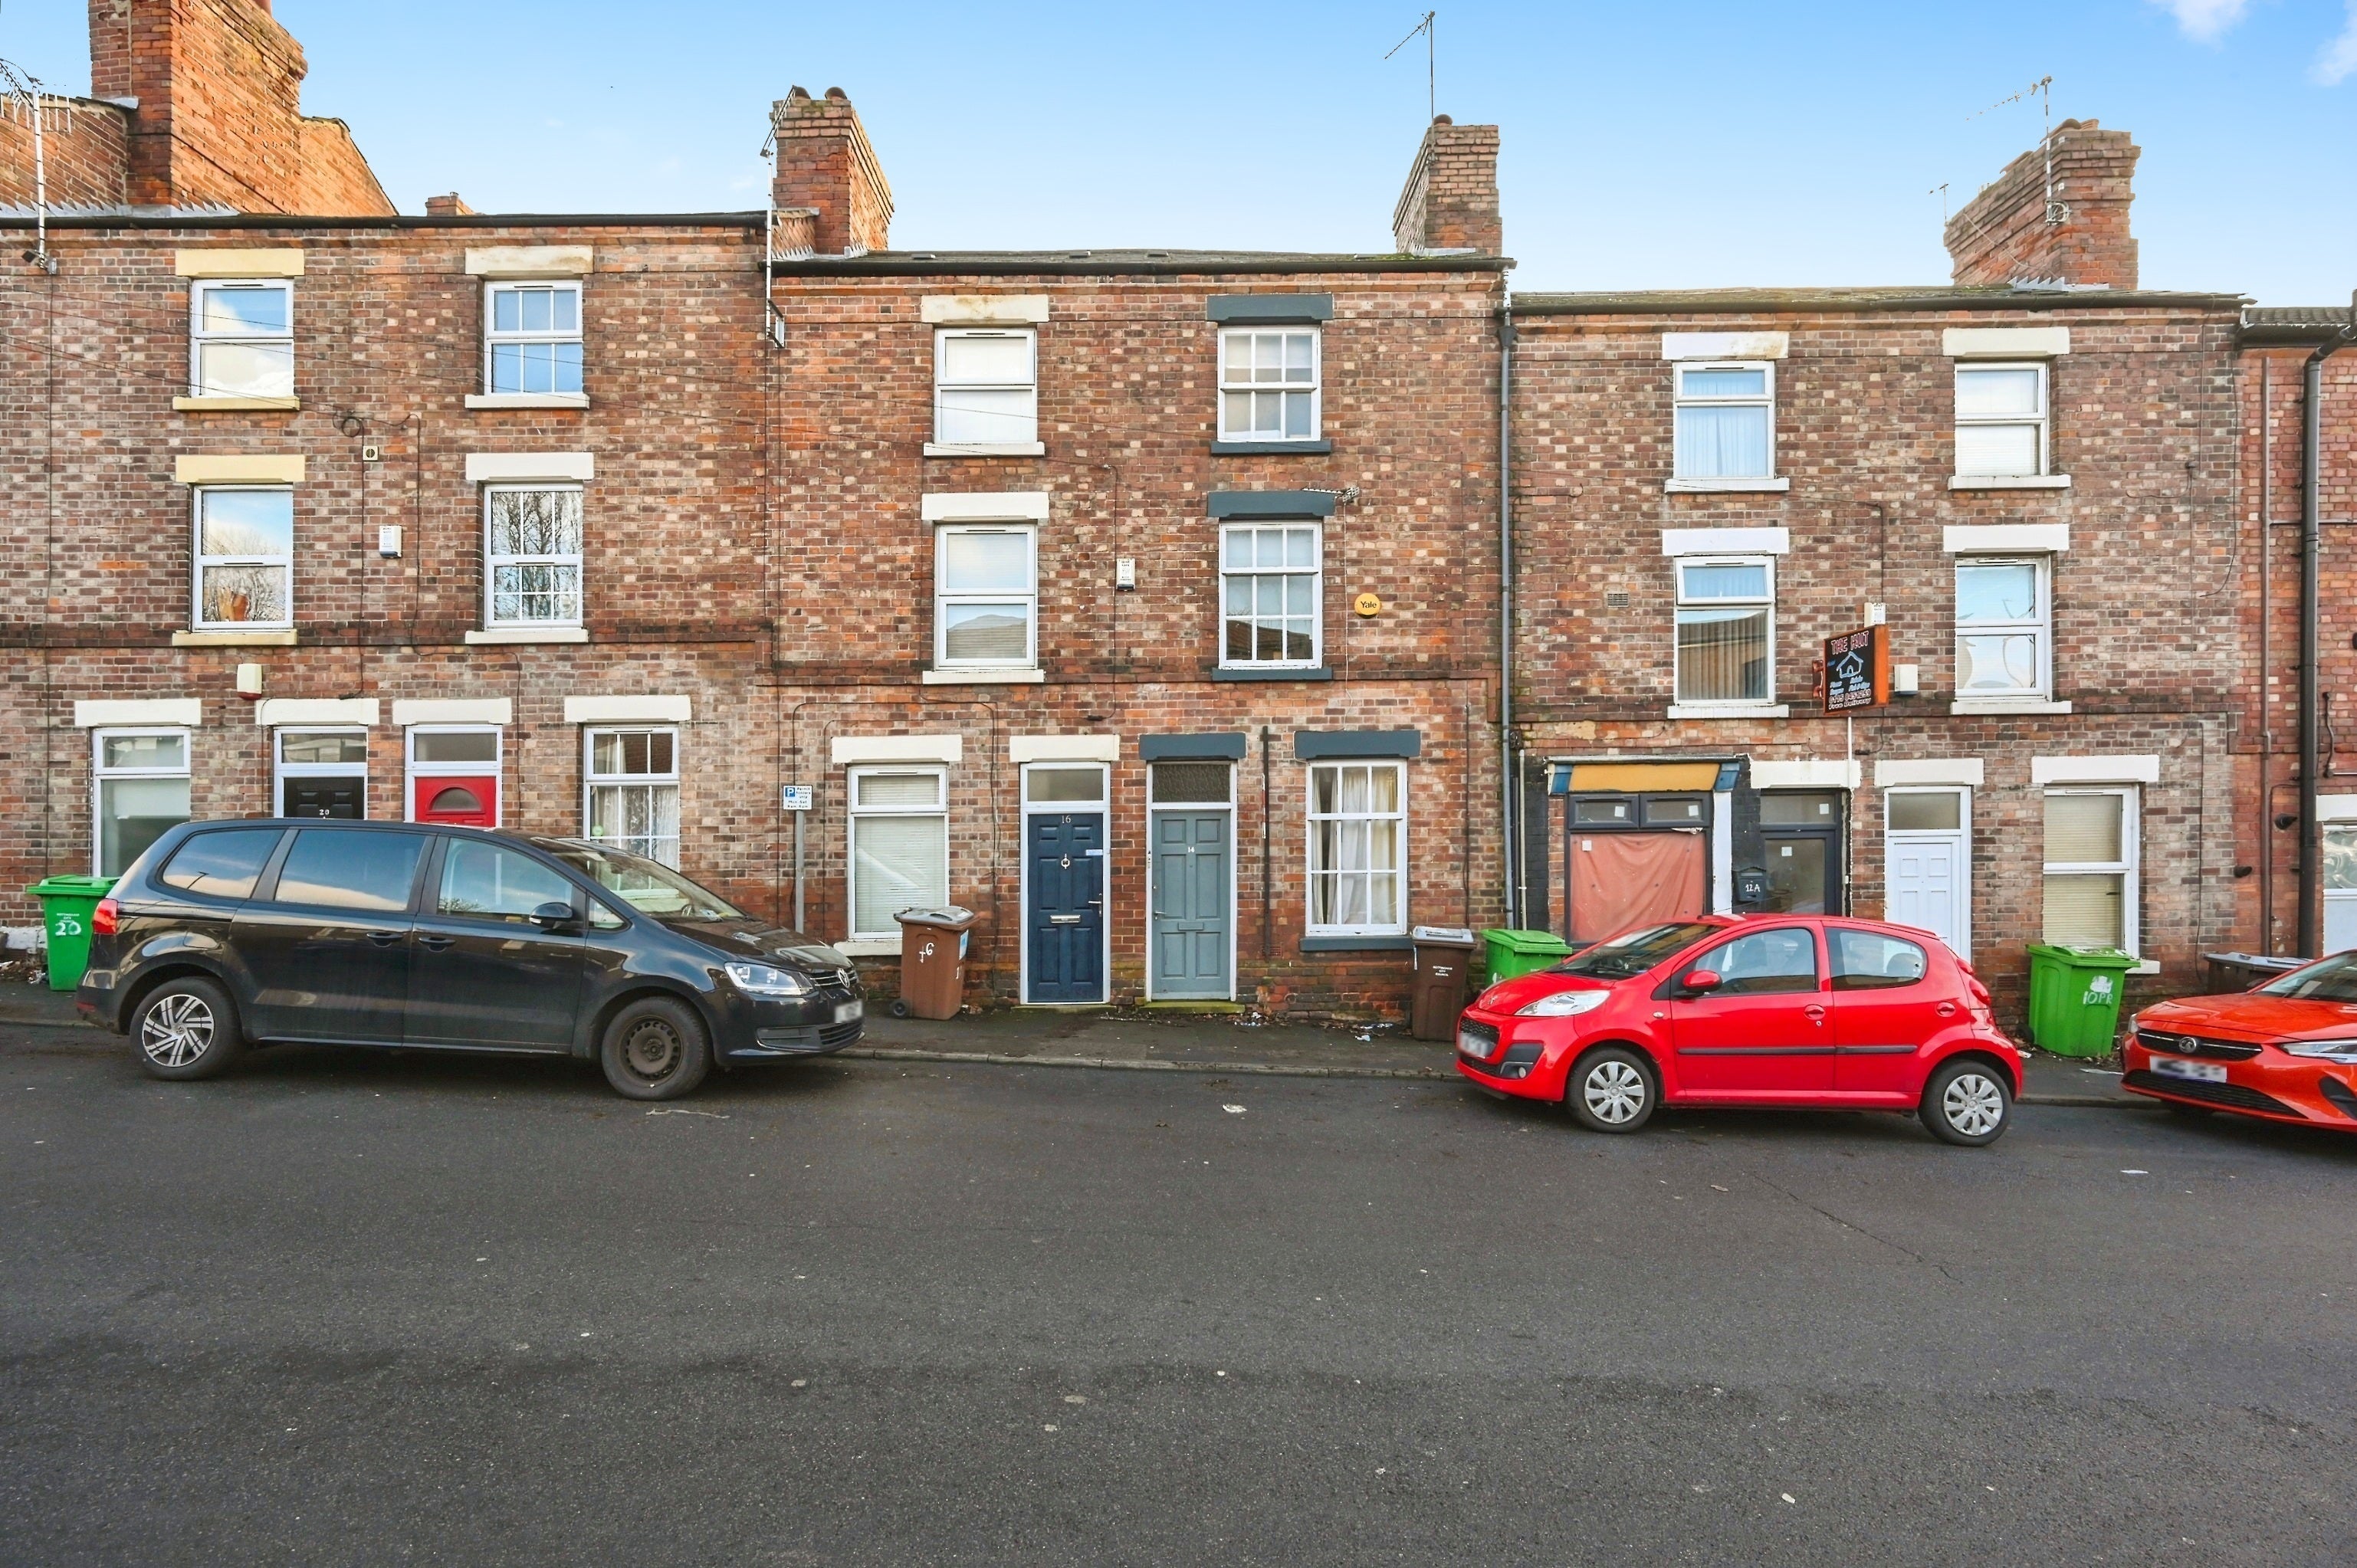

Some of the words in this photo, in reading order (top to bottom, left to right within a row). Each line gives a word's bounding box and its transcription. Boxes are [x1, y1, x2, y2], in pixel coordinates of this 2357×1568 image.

[787, 788, 794, 796] P
[1062, 815, 1072, 824] 16
[1745, 884, 1761, 892] 12A
[55, 922, 82, 936] 20
